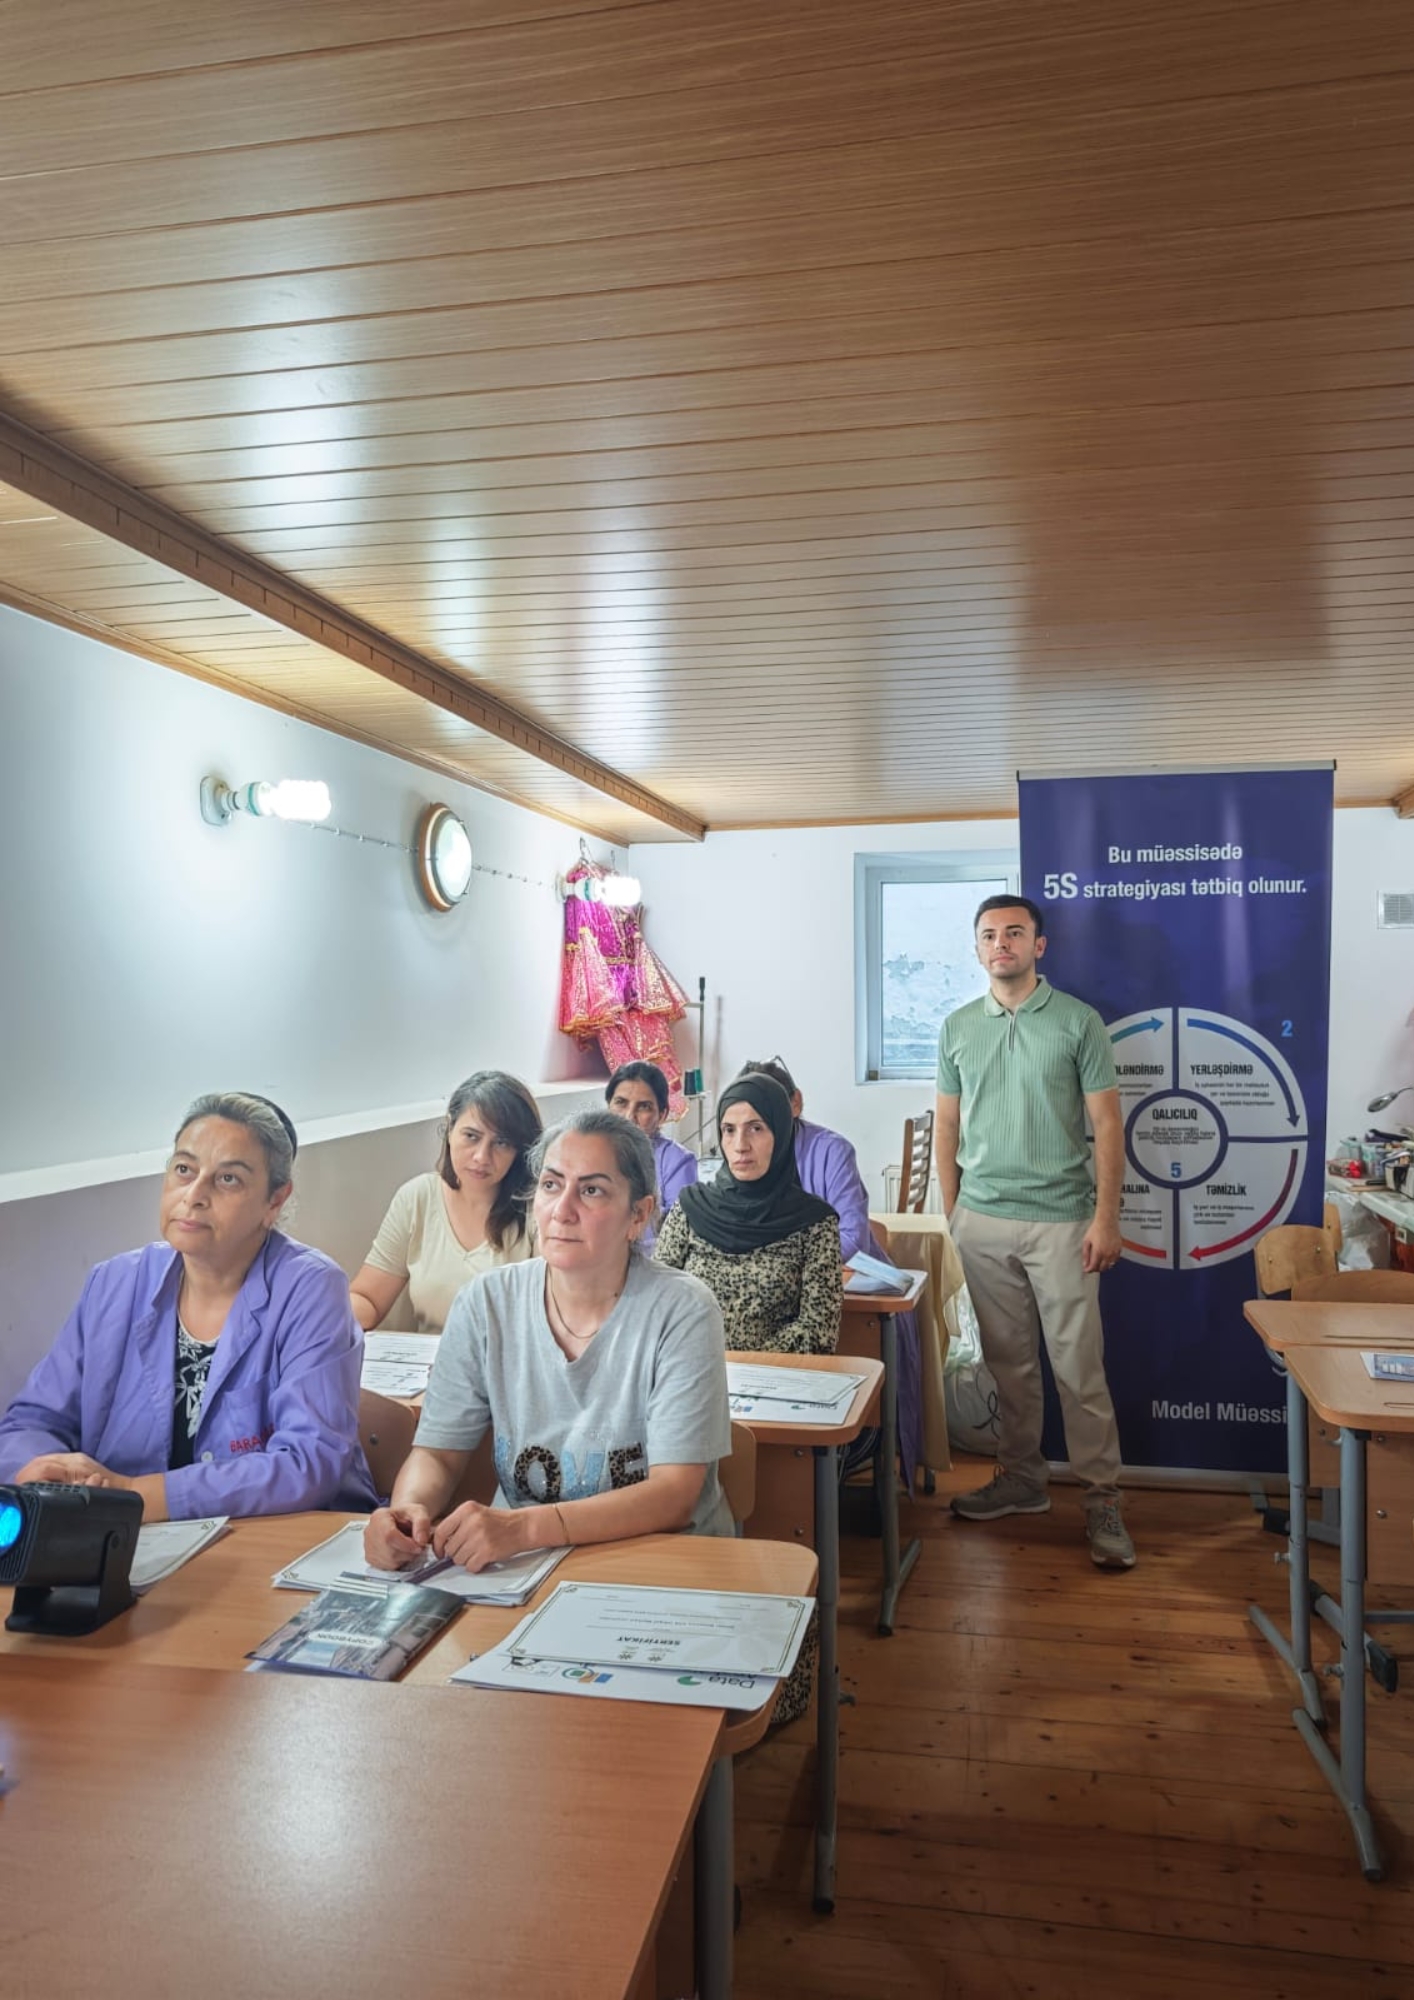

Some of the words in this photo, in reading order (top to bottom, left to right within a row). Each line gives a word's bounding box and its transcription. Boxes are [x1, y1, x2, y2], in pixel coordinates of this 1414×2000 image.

[1108, 846, 1131, 863] Bu
[1137, 843, 1243, 863] müəssisədə
[1043, 872, 1079, 900] 5S
[1083, 878, 1186, 900] strategiyası
[1191, 877, 1243, 897] tətbiq
[1248, 875, 1307, 895] olunur.
[1281, 1020, 1293, 1037] 2
[1190, 1062, 1254, 1078] YERLƏŞDİRMƏ
[1152, 1107, 1198, 1121] QALICILIQ
[1170, 1162, 1182, 1178] 5
[1206, 1183, 1247, 1197] TƏMİZLİK
[1152, 1400, 1210, 1420] Model
[1216, 1402, 1288, 1424] Müəssi
[708, 1676, 756, 1690] Data
